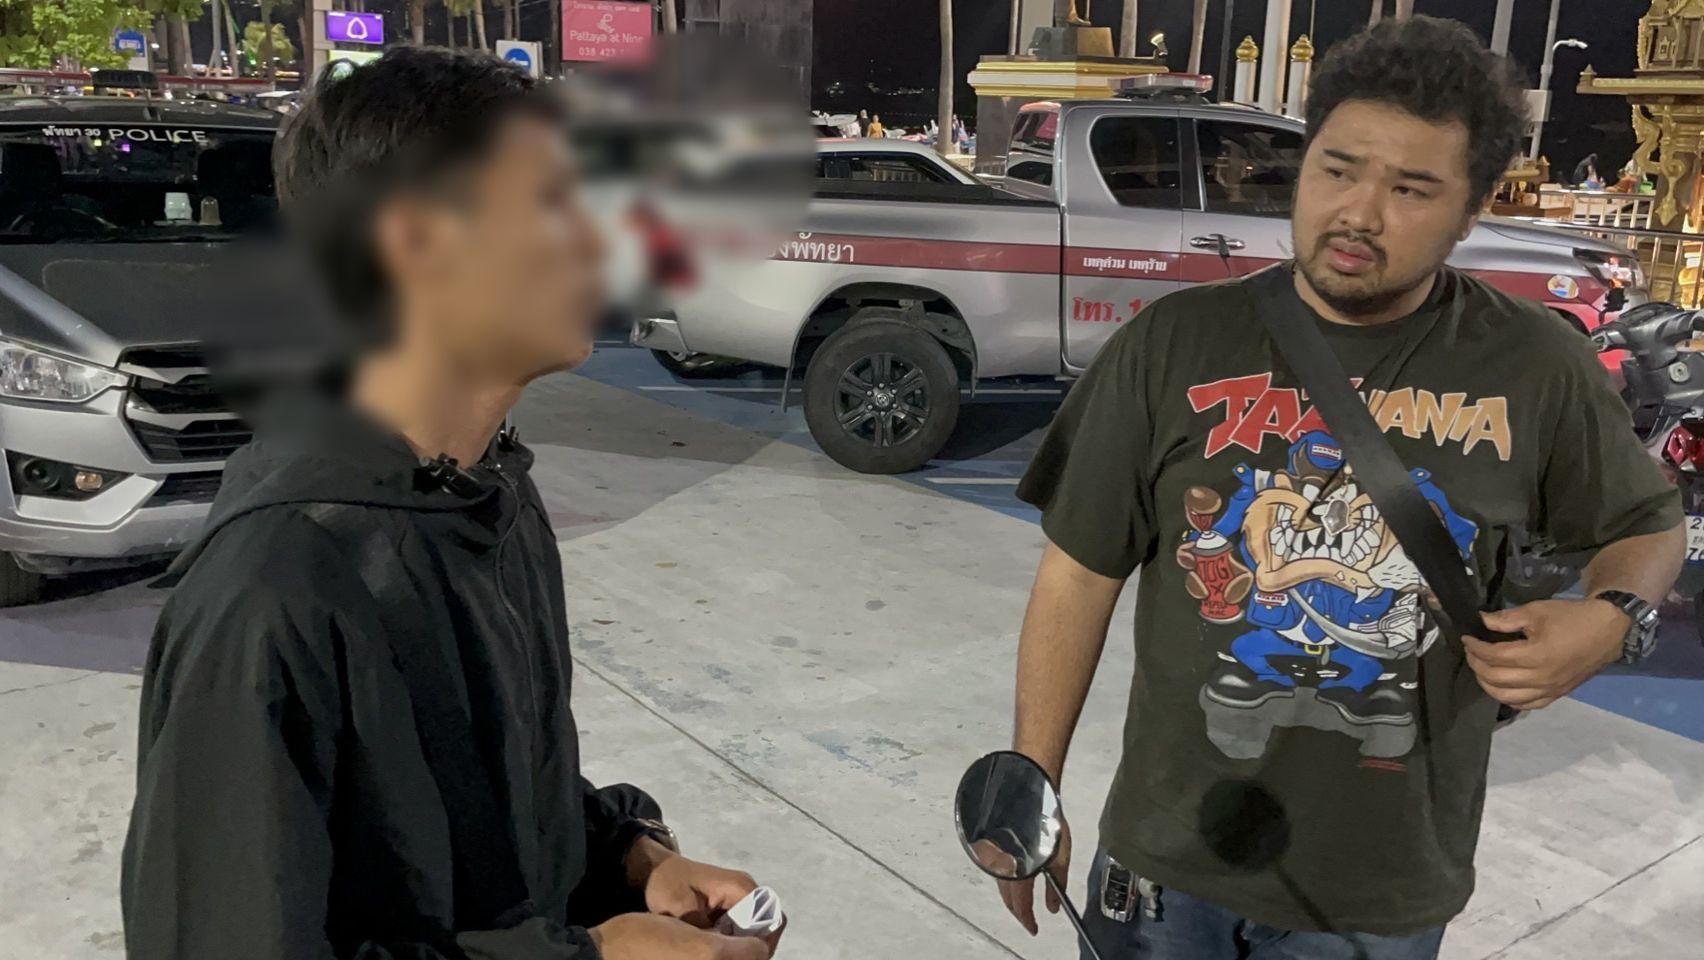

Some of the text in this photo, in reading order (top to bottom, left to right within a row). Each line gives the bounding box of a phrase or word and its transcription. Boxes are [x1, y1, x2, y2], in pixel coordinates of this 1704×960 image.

[569, 30, 607, 44] Pattaya
[609, 32, 620, 43] at
[42, 125, 208, 143] พัทยา 30 POLICE
[768, 232, 855, 262] งพัทยา
[1073, 295, 1122, 322] โทร.
[1187, 372, 1512, 461] TAANIA
